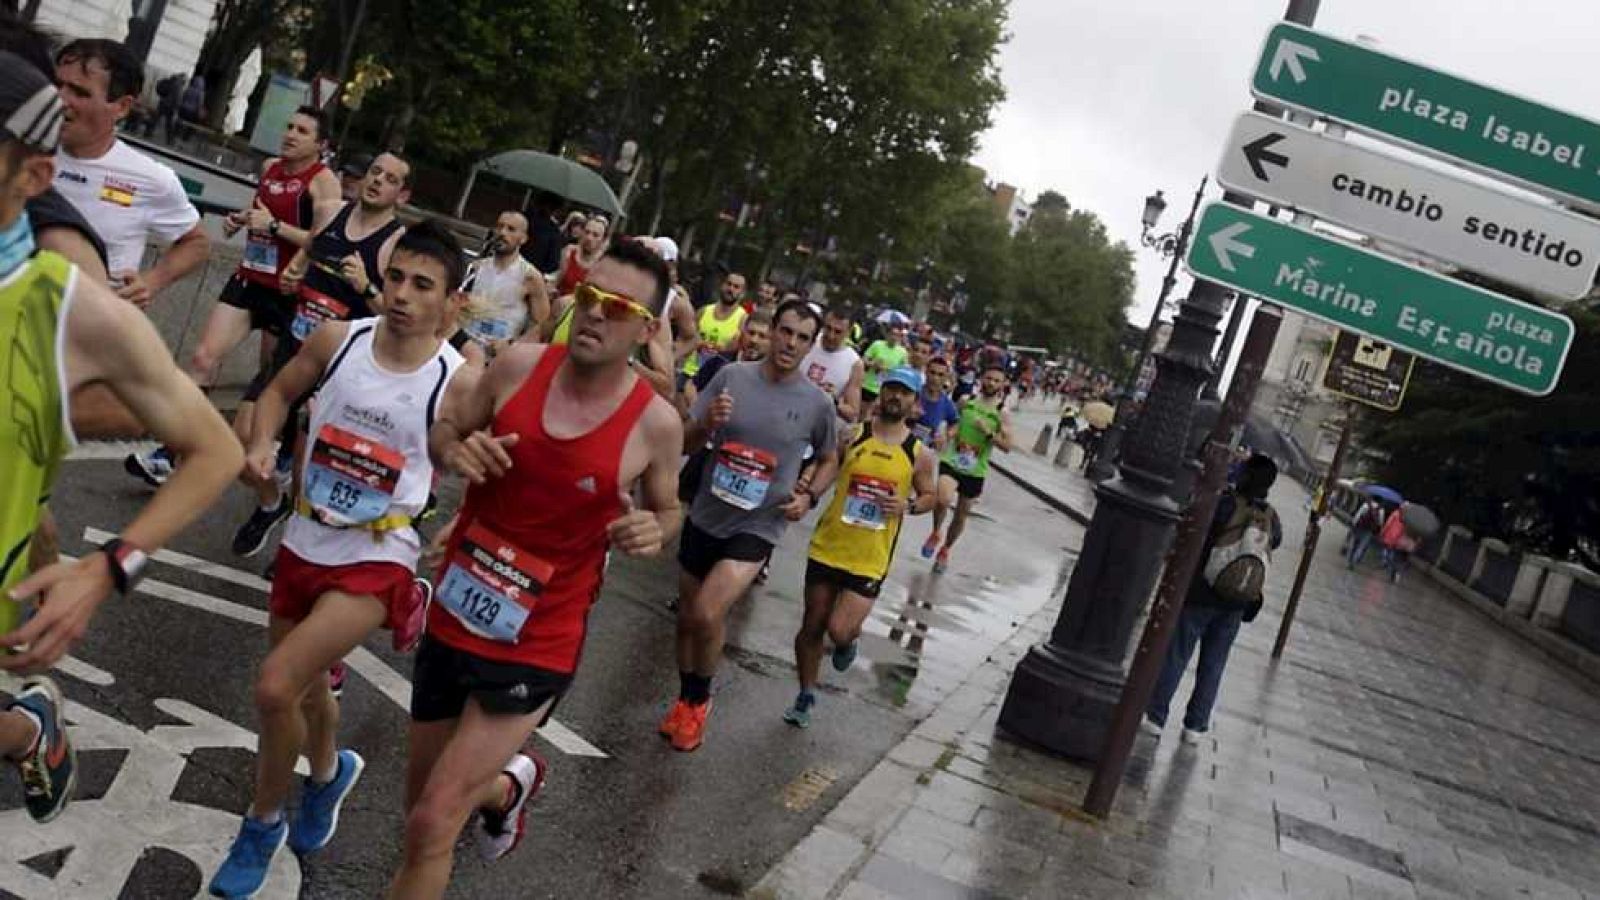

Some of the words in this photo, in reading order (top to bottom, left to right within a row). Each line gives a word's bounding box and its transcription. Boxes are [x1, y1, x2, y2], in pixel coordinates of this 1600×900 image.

[1379, 87, 1469, 131] plaza
[1482, 115, 1585, 168] Isabel
[1331, 173, 1443, 221] cambio
[1462, 215, 1583, 267] sentido
[1274, 262, 1377, 317] Marina
[1397, 305, 1543, 375] Española
[1487, 311, 1554, 345] plaza
[329, 481, 362, 509] 635
[493, 561, 531, 589] adidas
[461, 587, 501, 625] 1129
